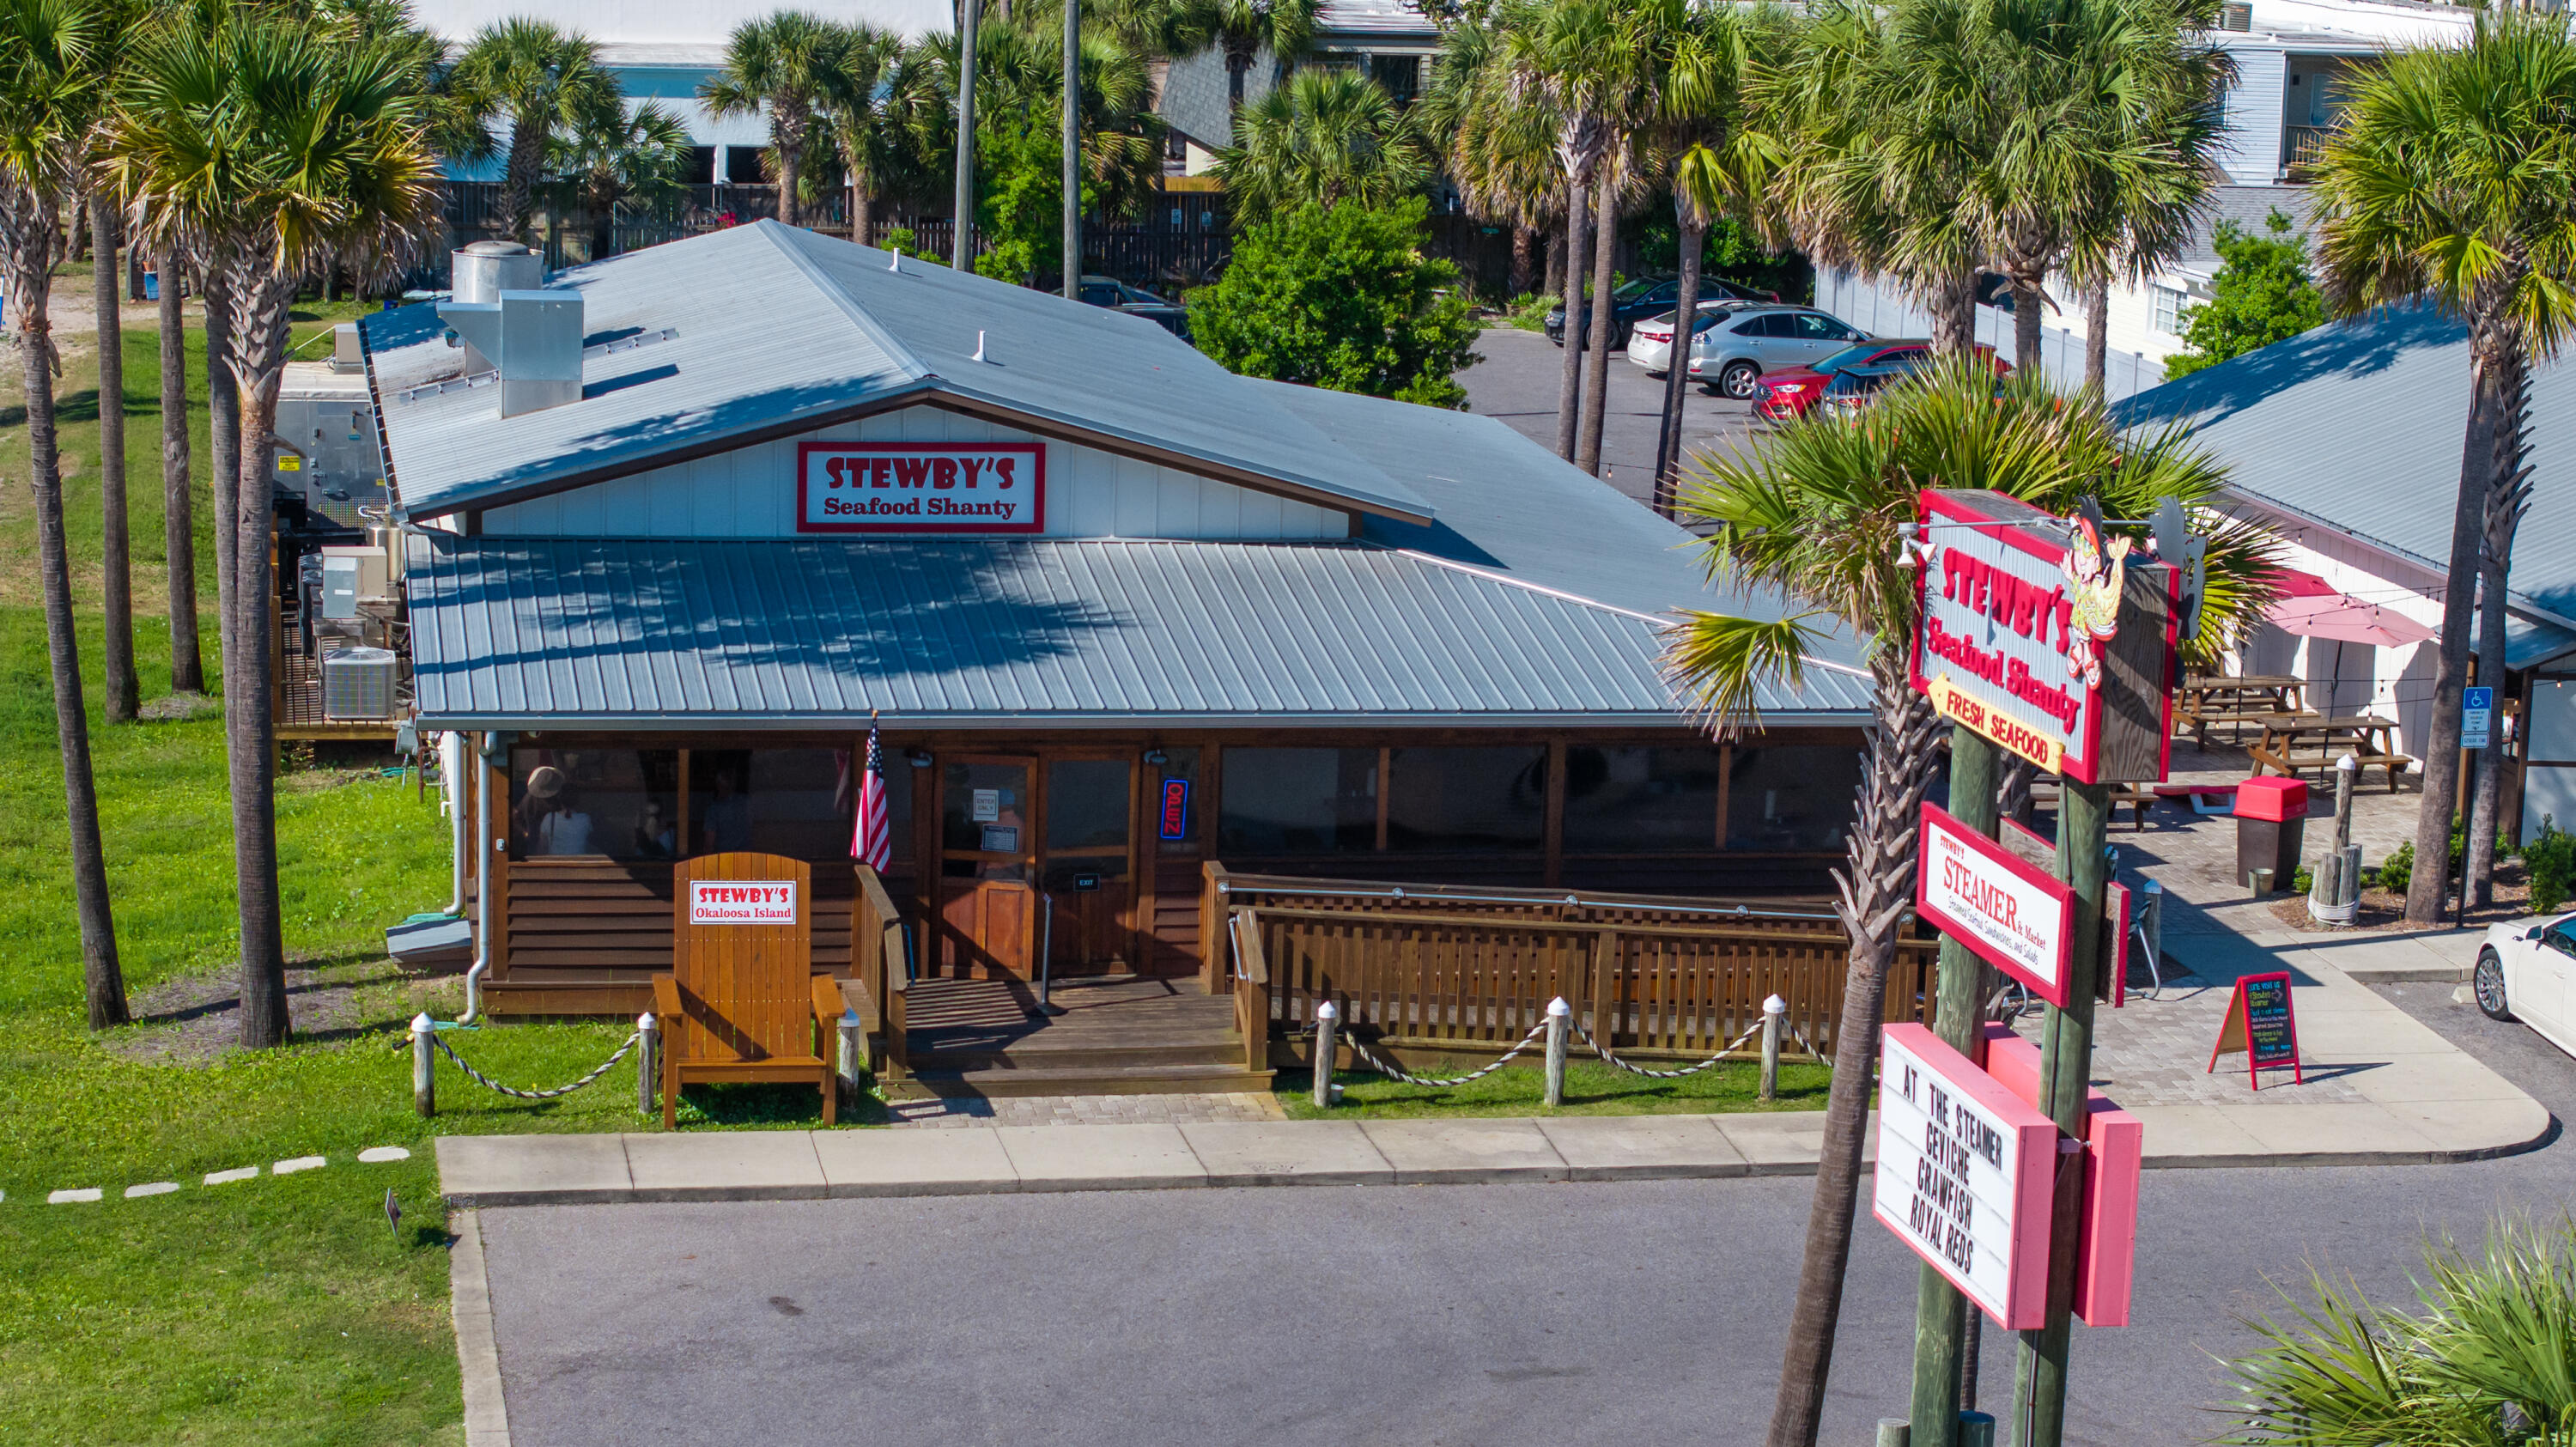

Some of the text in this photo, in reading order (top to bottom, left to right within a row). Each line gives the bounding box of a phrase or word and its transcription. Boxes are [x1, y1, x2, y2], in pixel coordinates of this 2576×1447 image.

[823, 497, 1017, 520] Seafood Shanty
[825, 456, 1015, 489] STEWBY'S
[1943, 546, 2074, 654] STEWBY'S
[1928, 617, 2081, 734] Seafood Shanty
[1946, 690, 2049, 764] FRESH SEAFOOD
[1163, 783, 1184, 834] OPEN
[696, 908, 792, 918] Okaloosa Island
[698, 887, 788, 903] STEWBY'S
[1944, 855, 2046, 950] STEAMER & Market
[1903, 1064, 2002, 1171] AT THE STEAMER
[1926, 1121, 1971, 1187] CEVICHE
[1917, 1156, 1973, 1231] CRAWFISH
[1911, 1193, 1974, 1275] ROYAL REDS
